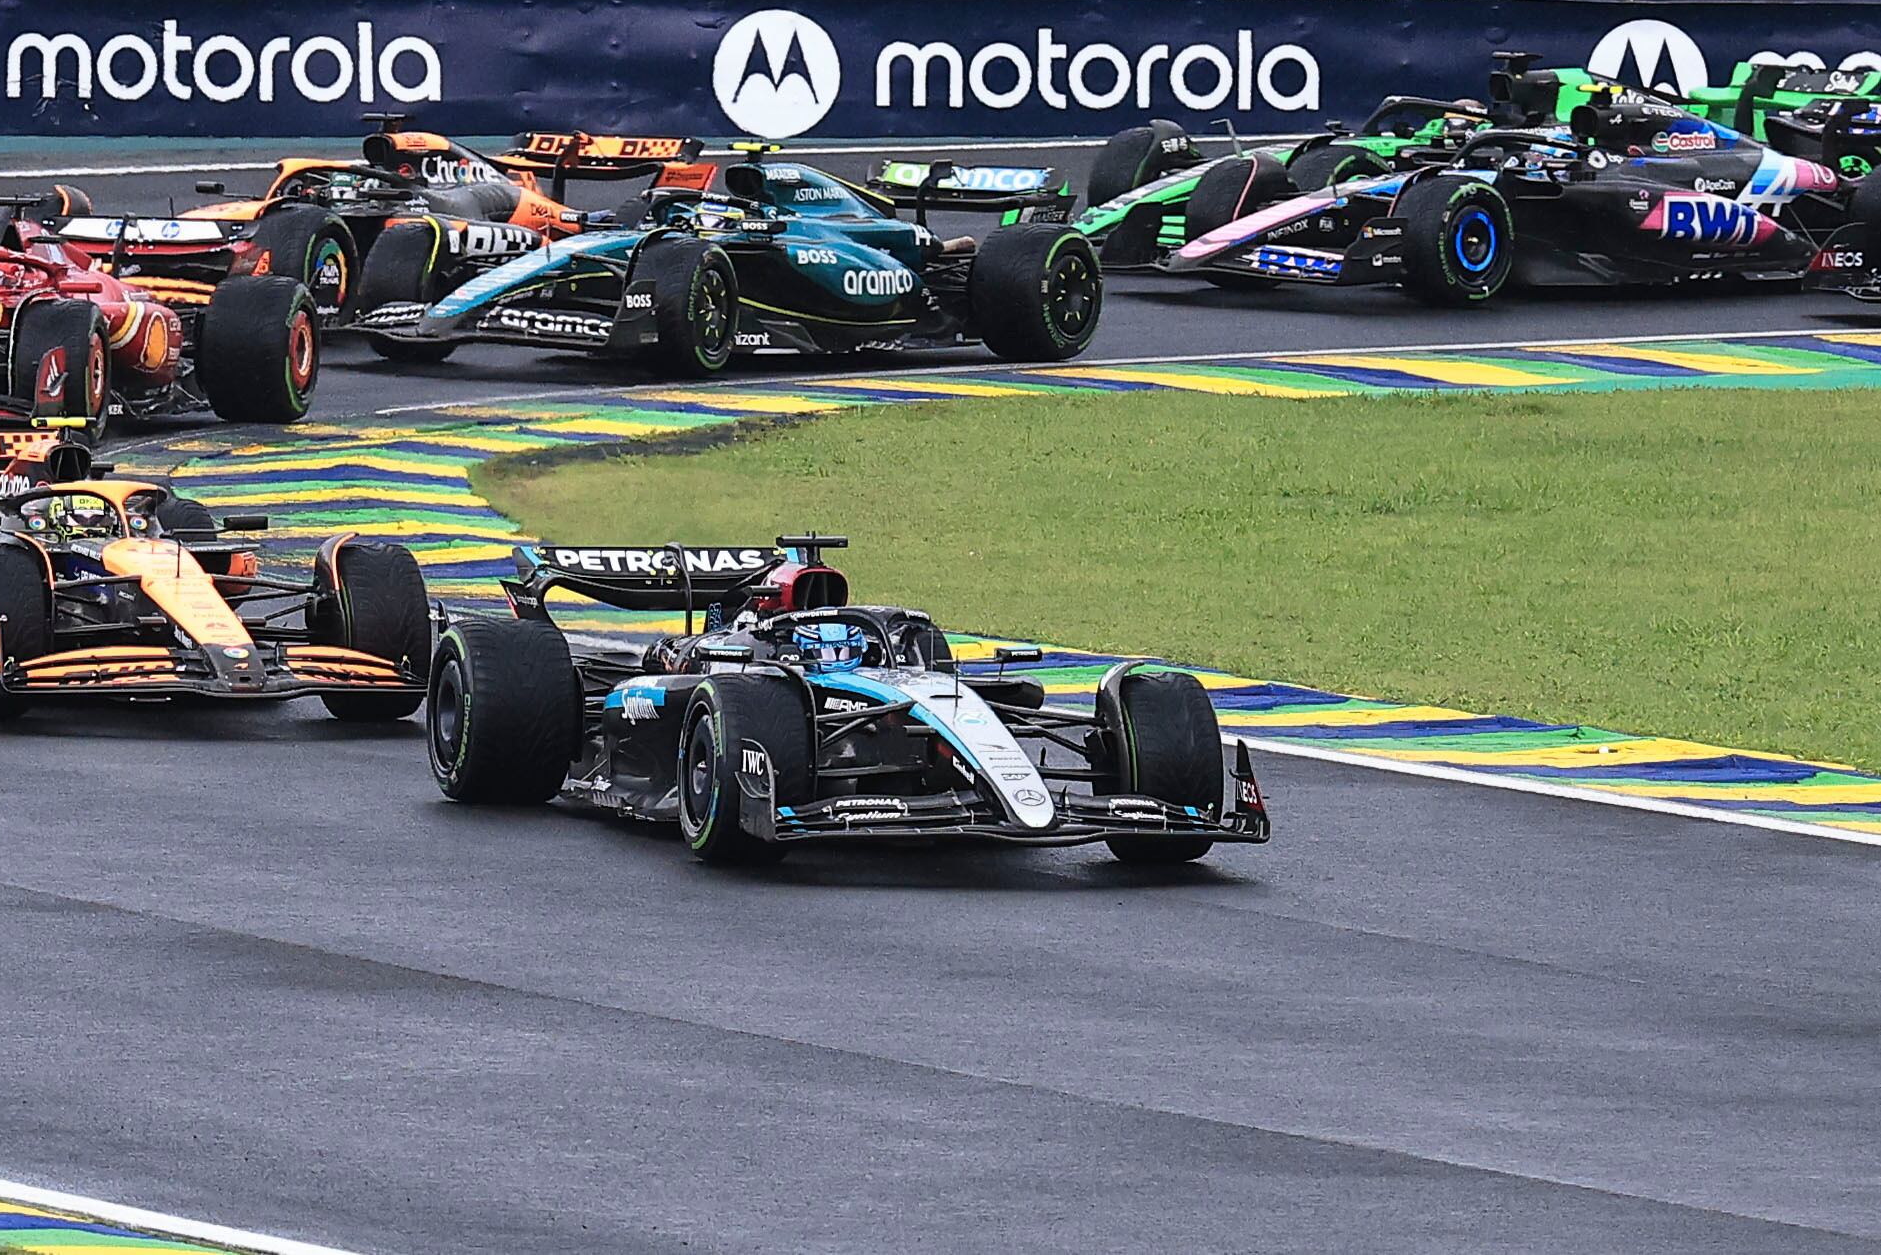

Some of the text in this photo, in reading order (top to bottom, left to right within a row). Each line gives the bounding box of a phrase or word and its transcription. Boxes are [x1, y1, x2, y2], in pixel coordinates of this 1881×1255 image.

[6, 19, 442, 103] motorola
[876, 28, 1320, 111] motorola
[1669, 132, 1716, 150] Castrol
[422, 155, 501, 186] Chrome
[894, 164, 1038, 189] amco
[793, 188, 823, 202] ASTON
[741, 222, 768, 231] BOSS
[1267, 219, 1310, 241] INFINOX
[1664, 201, 1758, 244] BWT
[796, 249, 839, 265] BOSS
[1822, 252, 1863, 267] INEOS
[843, 269, 914, 295] aramco
[626, 294, 653, 308] BOSS
[554, 548, 765, 572] PETRONAS
[709, 648, 744, 657] PETRONAS
[896, 654, 906, 663] 42
[741, 748, 766, 777] IWC
[1236, 778, 1258, 804] INEOS
[835, 798, 901, 808] PETRONAS
[1109, 798, 1159, 809] PETRONAS
